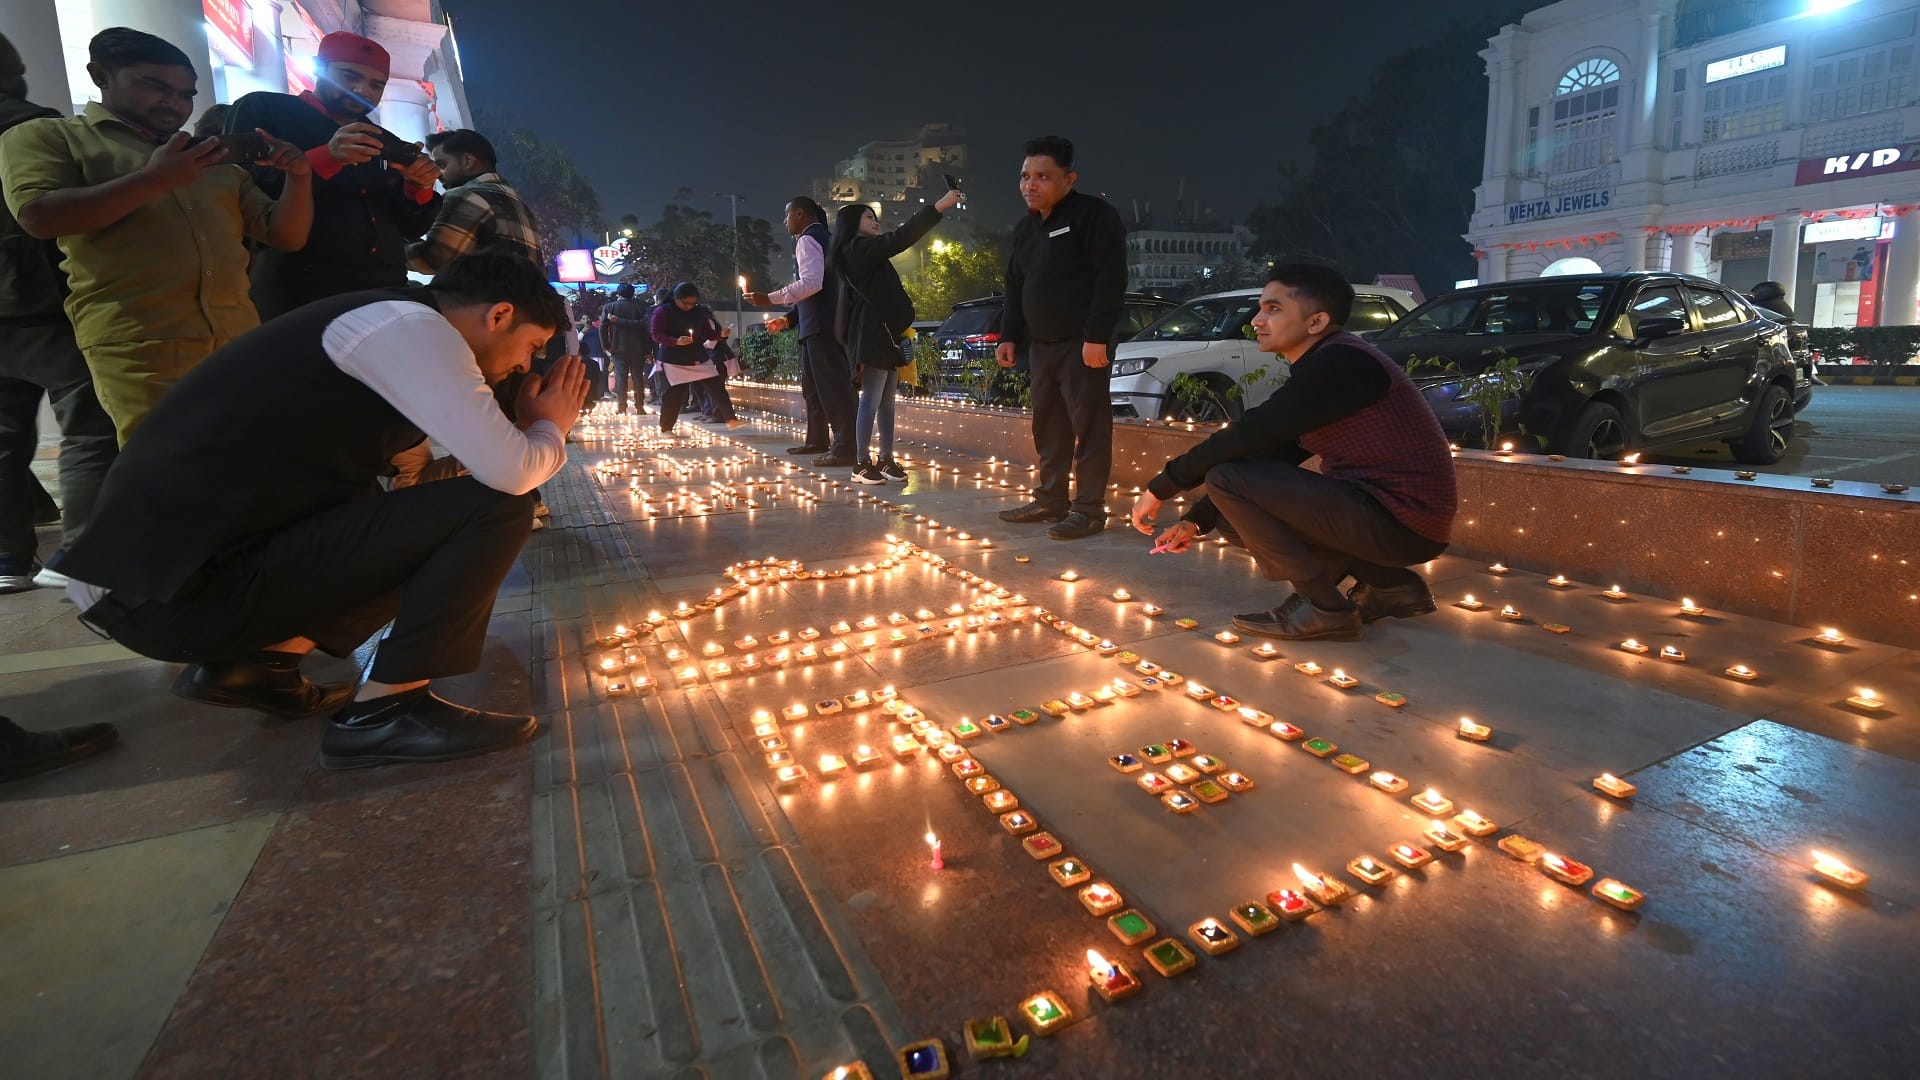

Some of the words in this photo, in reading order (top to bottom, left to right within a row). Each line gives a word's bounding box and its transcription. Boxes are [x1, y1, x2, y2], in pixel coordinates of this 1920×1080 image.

[1509, 200, 1551, 221] MEHTA
[1555, 190, 1610, 213] JEWELS
[600, 249, 619, 258] HP
